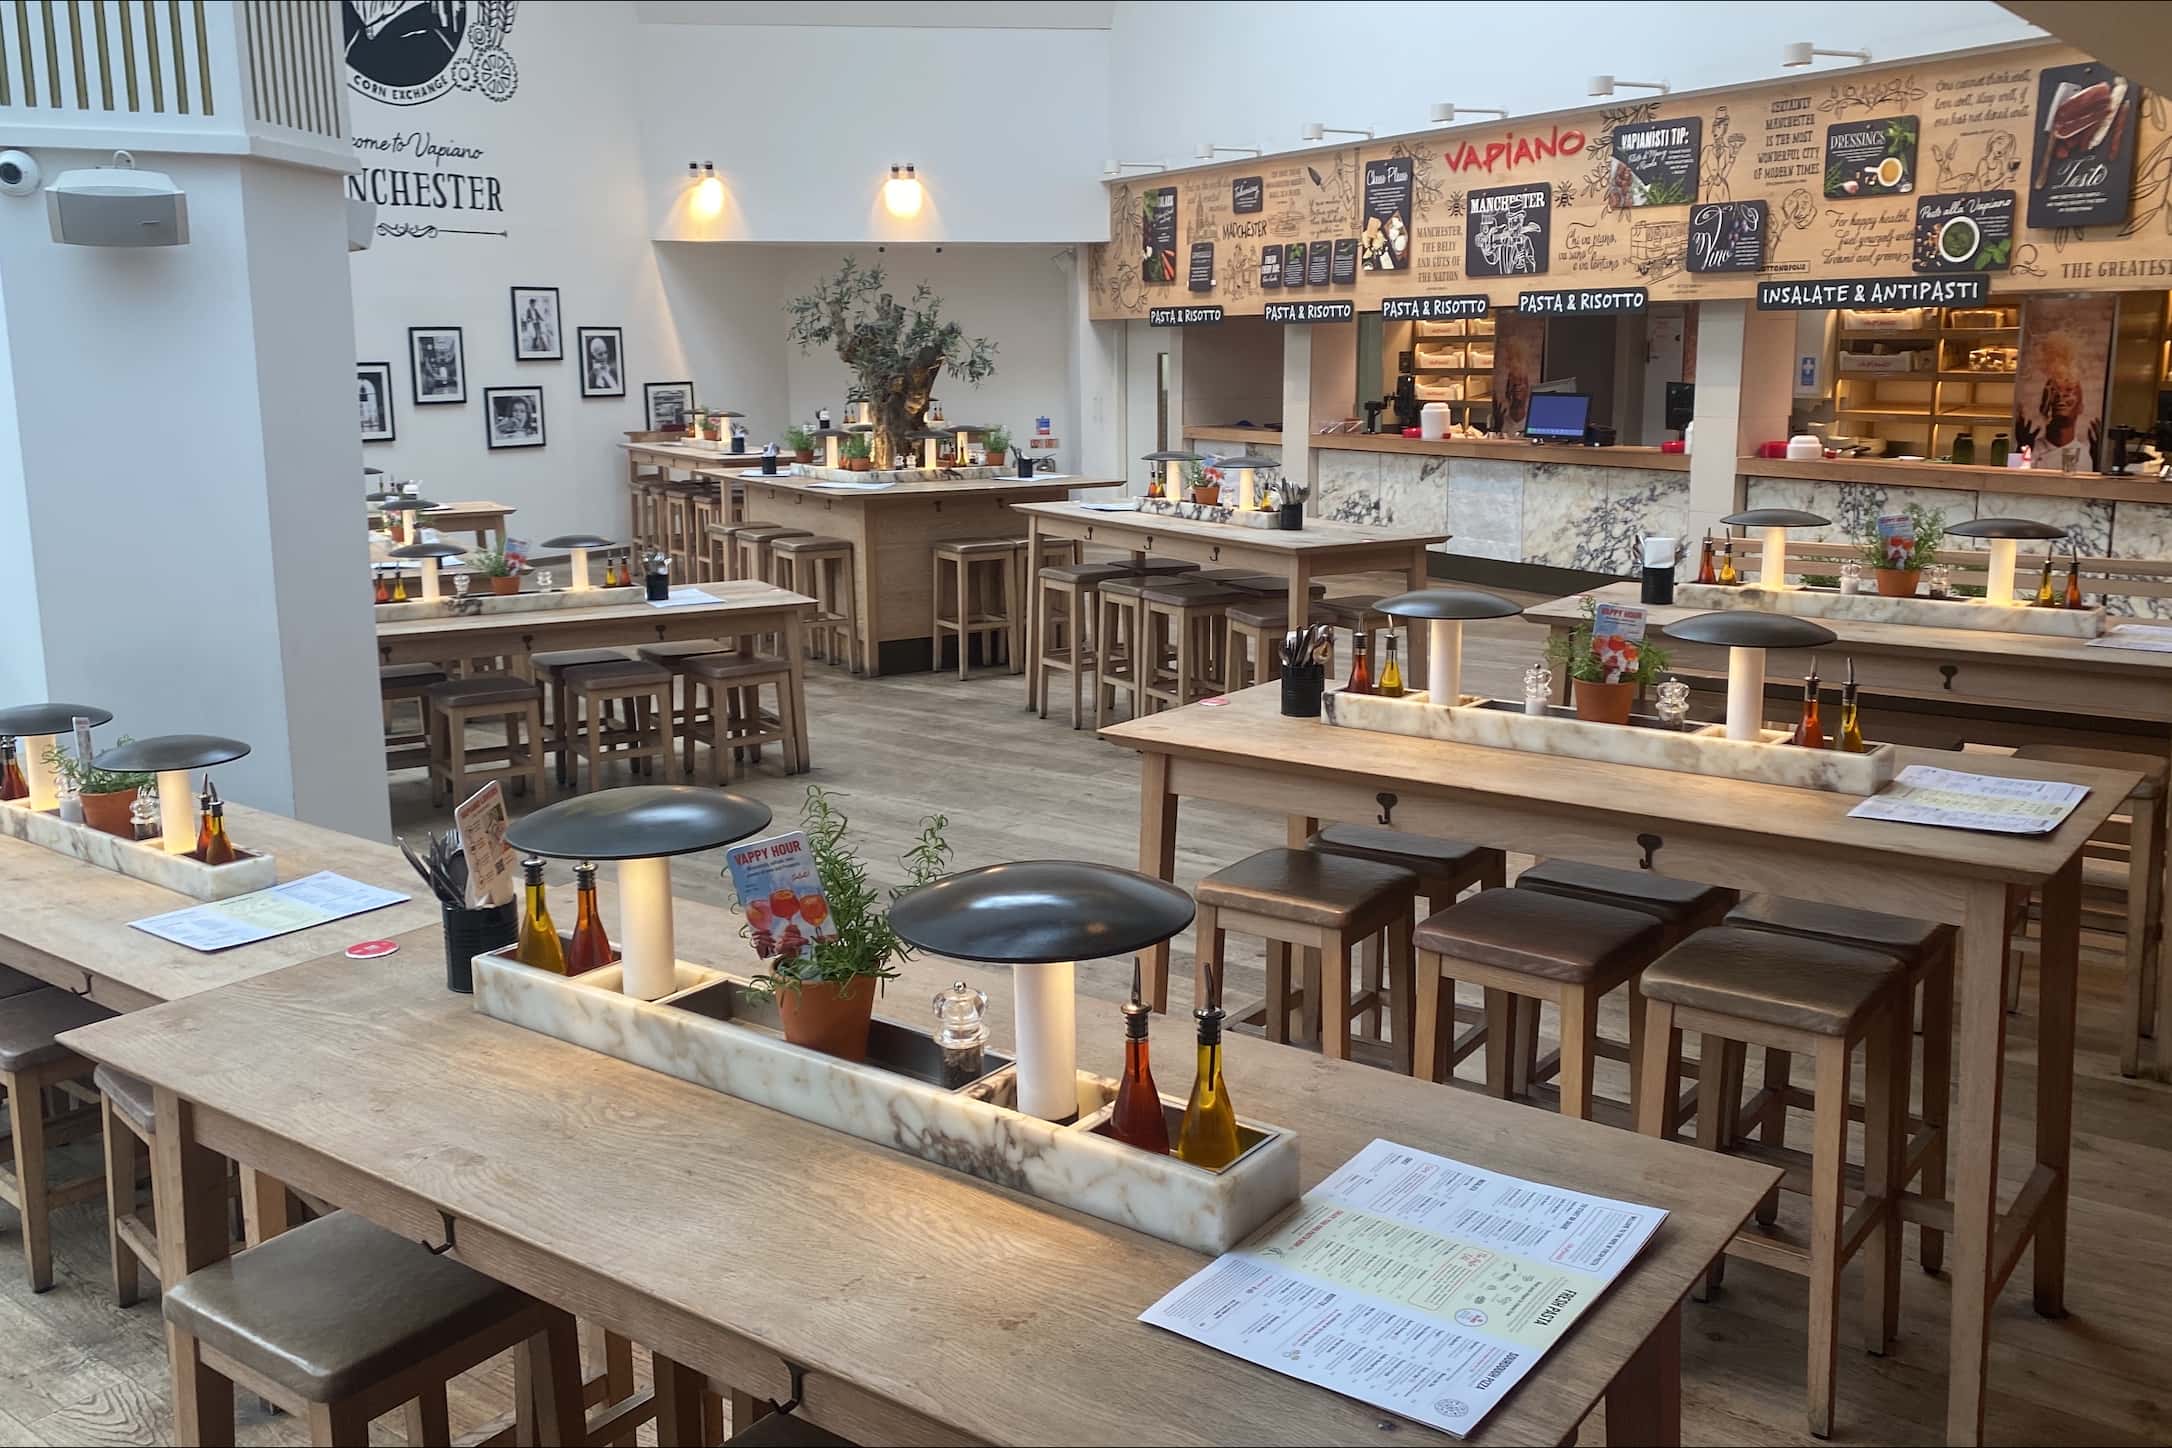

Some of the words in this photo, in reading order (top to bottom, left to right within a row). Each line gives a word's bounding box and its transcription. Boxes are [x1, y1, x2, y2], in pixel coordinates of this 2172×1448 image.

[353, 74, 388, 98] CORN
[392, 74, 449, 100] EXCHANGE
[1671, 126, 1690, 146] TIP:
[1830, 130, 1887, 150] DRESSINGS
[351, 136, 392, 151] come
[405, 131, 485, 169] Vapiano
[1443, 125, 1587, 174] VAPIANO
[1801, 146, 1821, 161] CITY
[1795, 162, 1820, 177] TIMES
[348, 167, 504, 212] NCHESTER
[1470, 191, 1546, 214] MANCHESTER
[2060, 262, 2093, 279] THE
[1519, 293, 1564, 313] PASTA
[1565, 294, 1577, 311] &
[1580, 292, 1644, 311] RISOTTO
[1762, 284, 1850, 305] INSALATE
[1853, 284, 1866, 303] &
[1870, 281, 1979, 303] ANTIPASTI
[1150, 309, 1176, 325] PASTA
[1177, 310, 1184, 323] &
[1184, 309, 1222, 322] RISOTTO
[1265, 305, 1296, 321] PASTA
[1298, 306, 1306, 320] &
[1307, 304, 1351, 320] RISOTTO
[1383, 300, 1420, 318] PASTA
[1422, 300, 1431, 316] &
[1434, 299, 1486, 316] RISOTTO
[733, 847, 768, 866] VAPPY
[770, 840, 803, 857] HOUR
[1550, 1288, 1577, 1307] FRESH
[1532, 1305, 1561, 1326] PASTA
